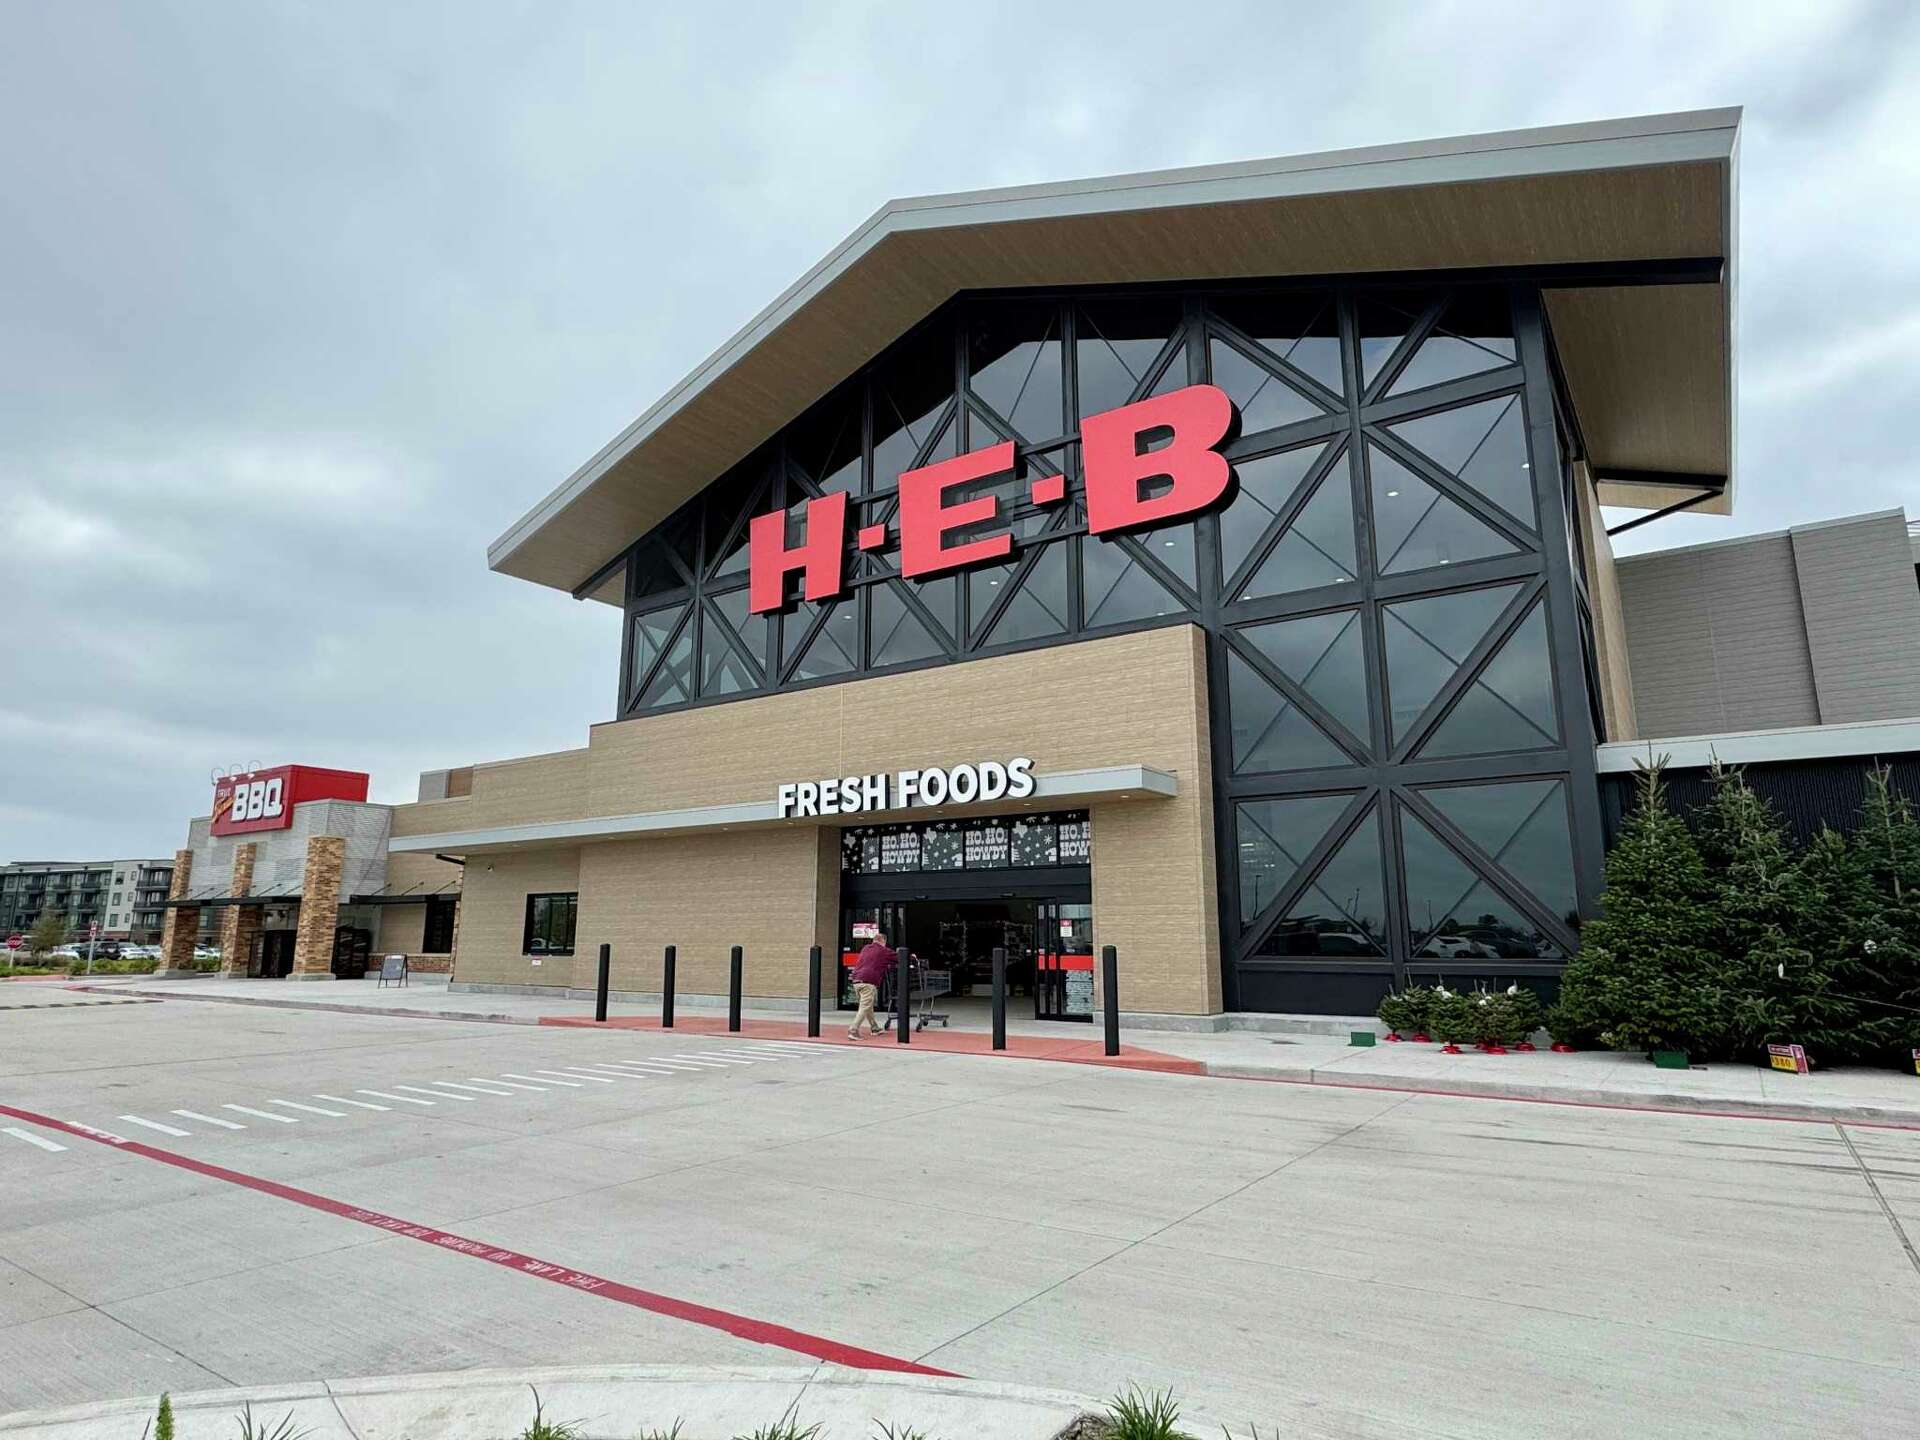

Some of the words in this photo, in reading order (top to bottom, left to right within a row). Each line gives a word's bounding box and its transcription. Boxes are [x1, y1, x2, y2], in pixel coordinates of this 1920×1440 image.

[778, 773, 889, 818] FRESH
[898, 757, 1036, 808] FOODS
[231, 778, 283, 821] BBQ
[882, 849, 920, 865] HOWDY
[965, 845, 1008, 861] HOWDY
[1059, 840, 1091, 857] HOW
